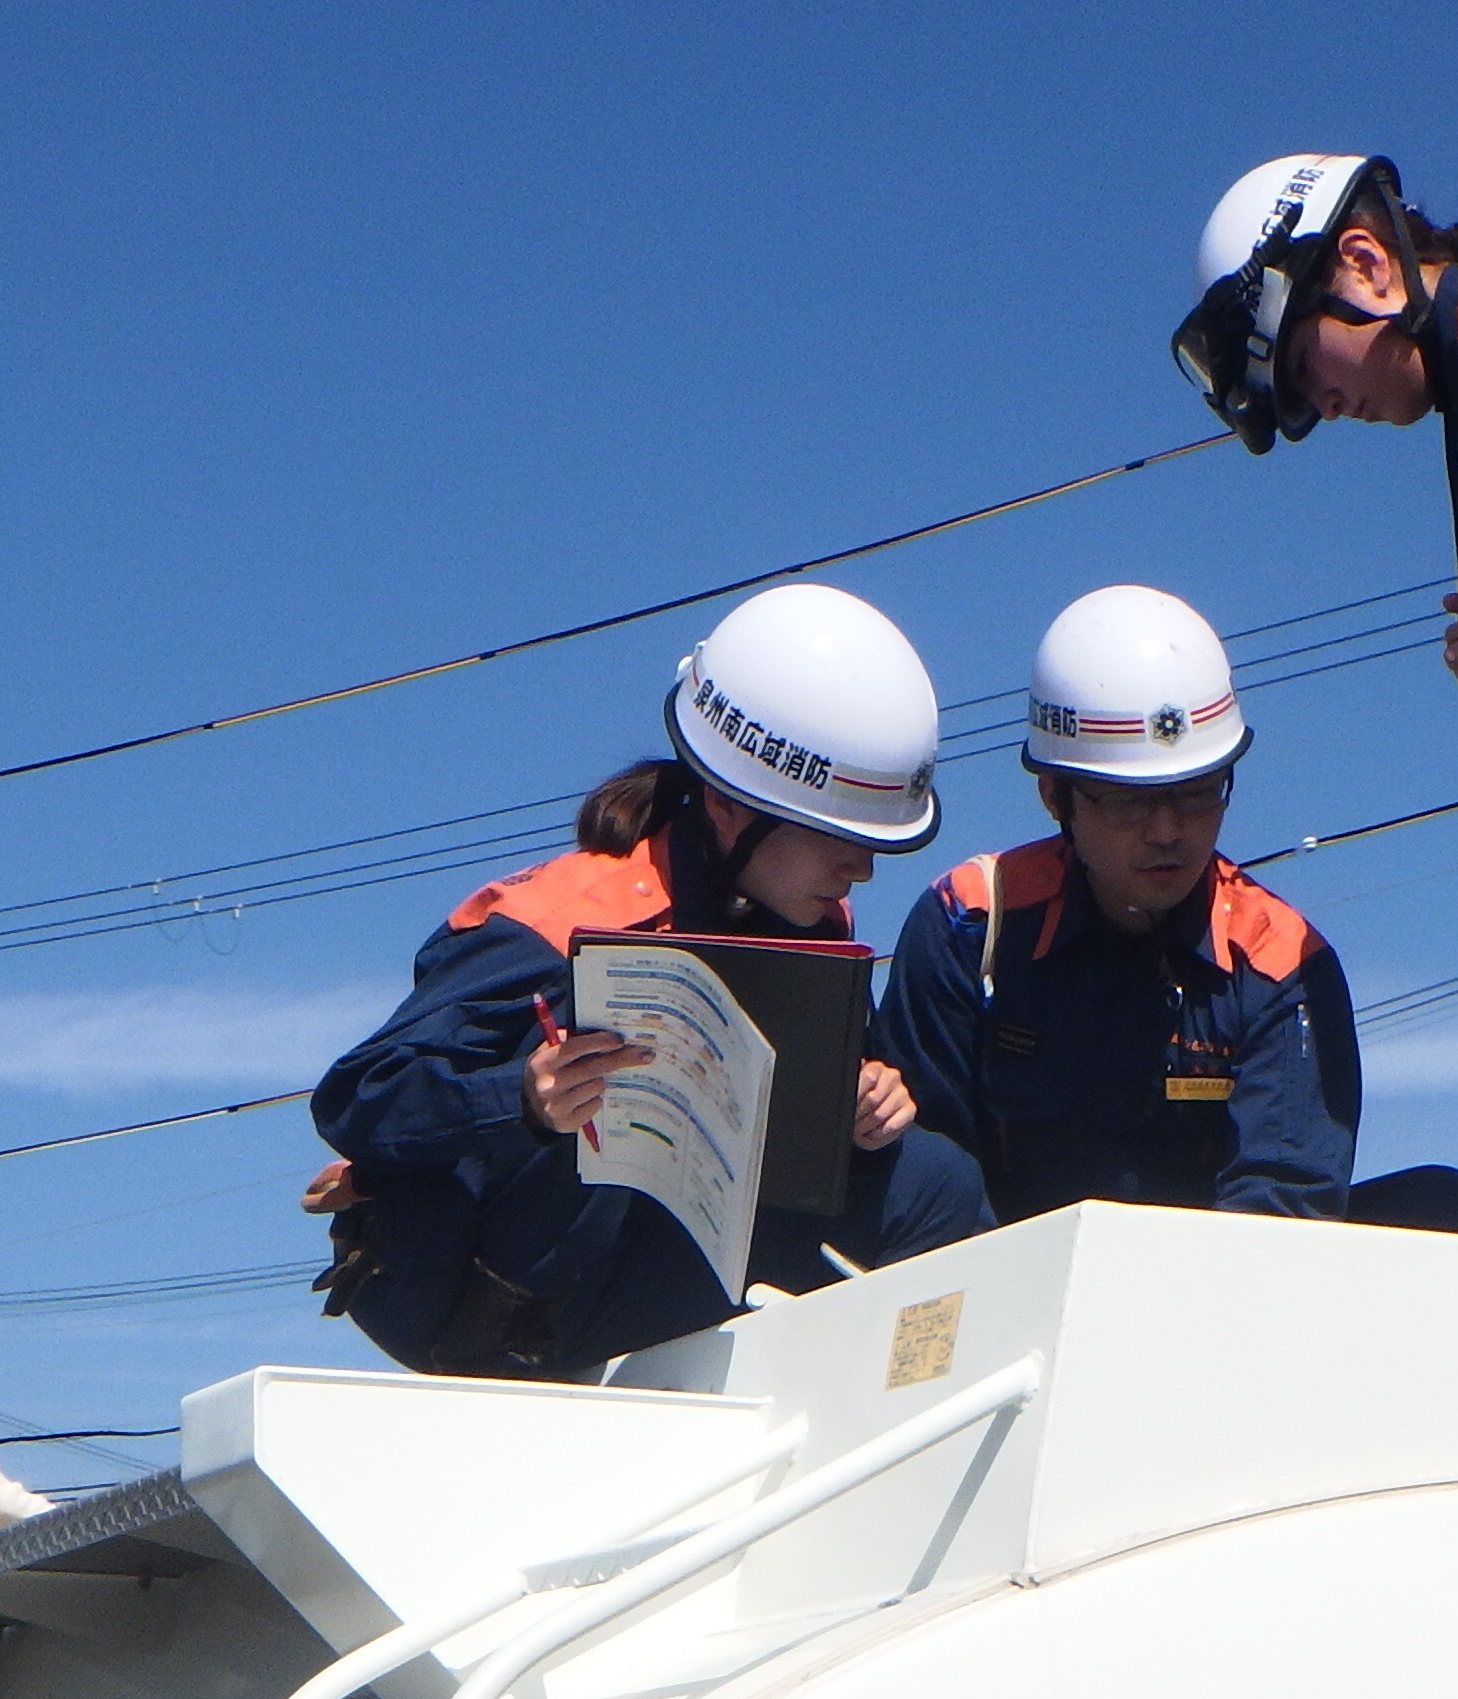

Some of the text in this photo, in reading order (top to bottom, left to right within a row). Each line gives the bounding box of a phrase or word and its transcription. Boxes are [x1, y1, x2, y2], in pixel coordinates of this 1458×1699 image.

[693, 679, 832, 790] 泉州南広域消防
